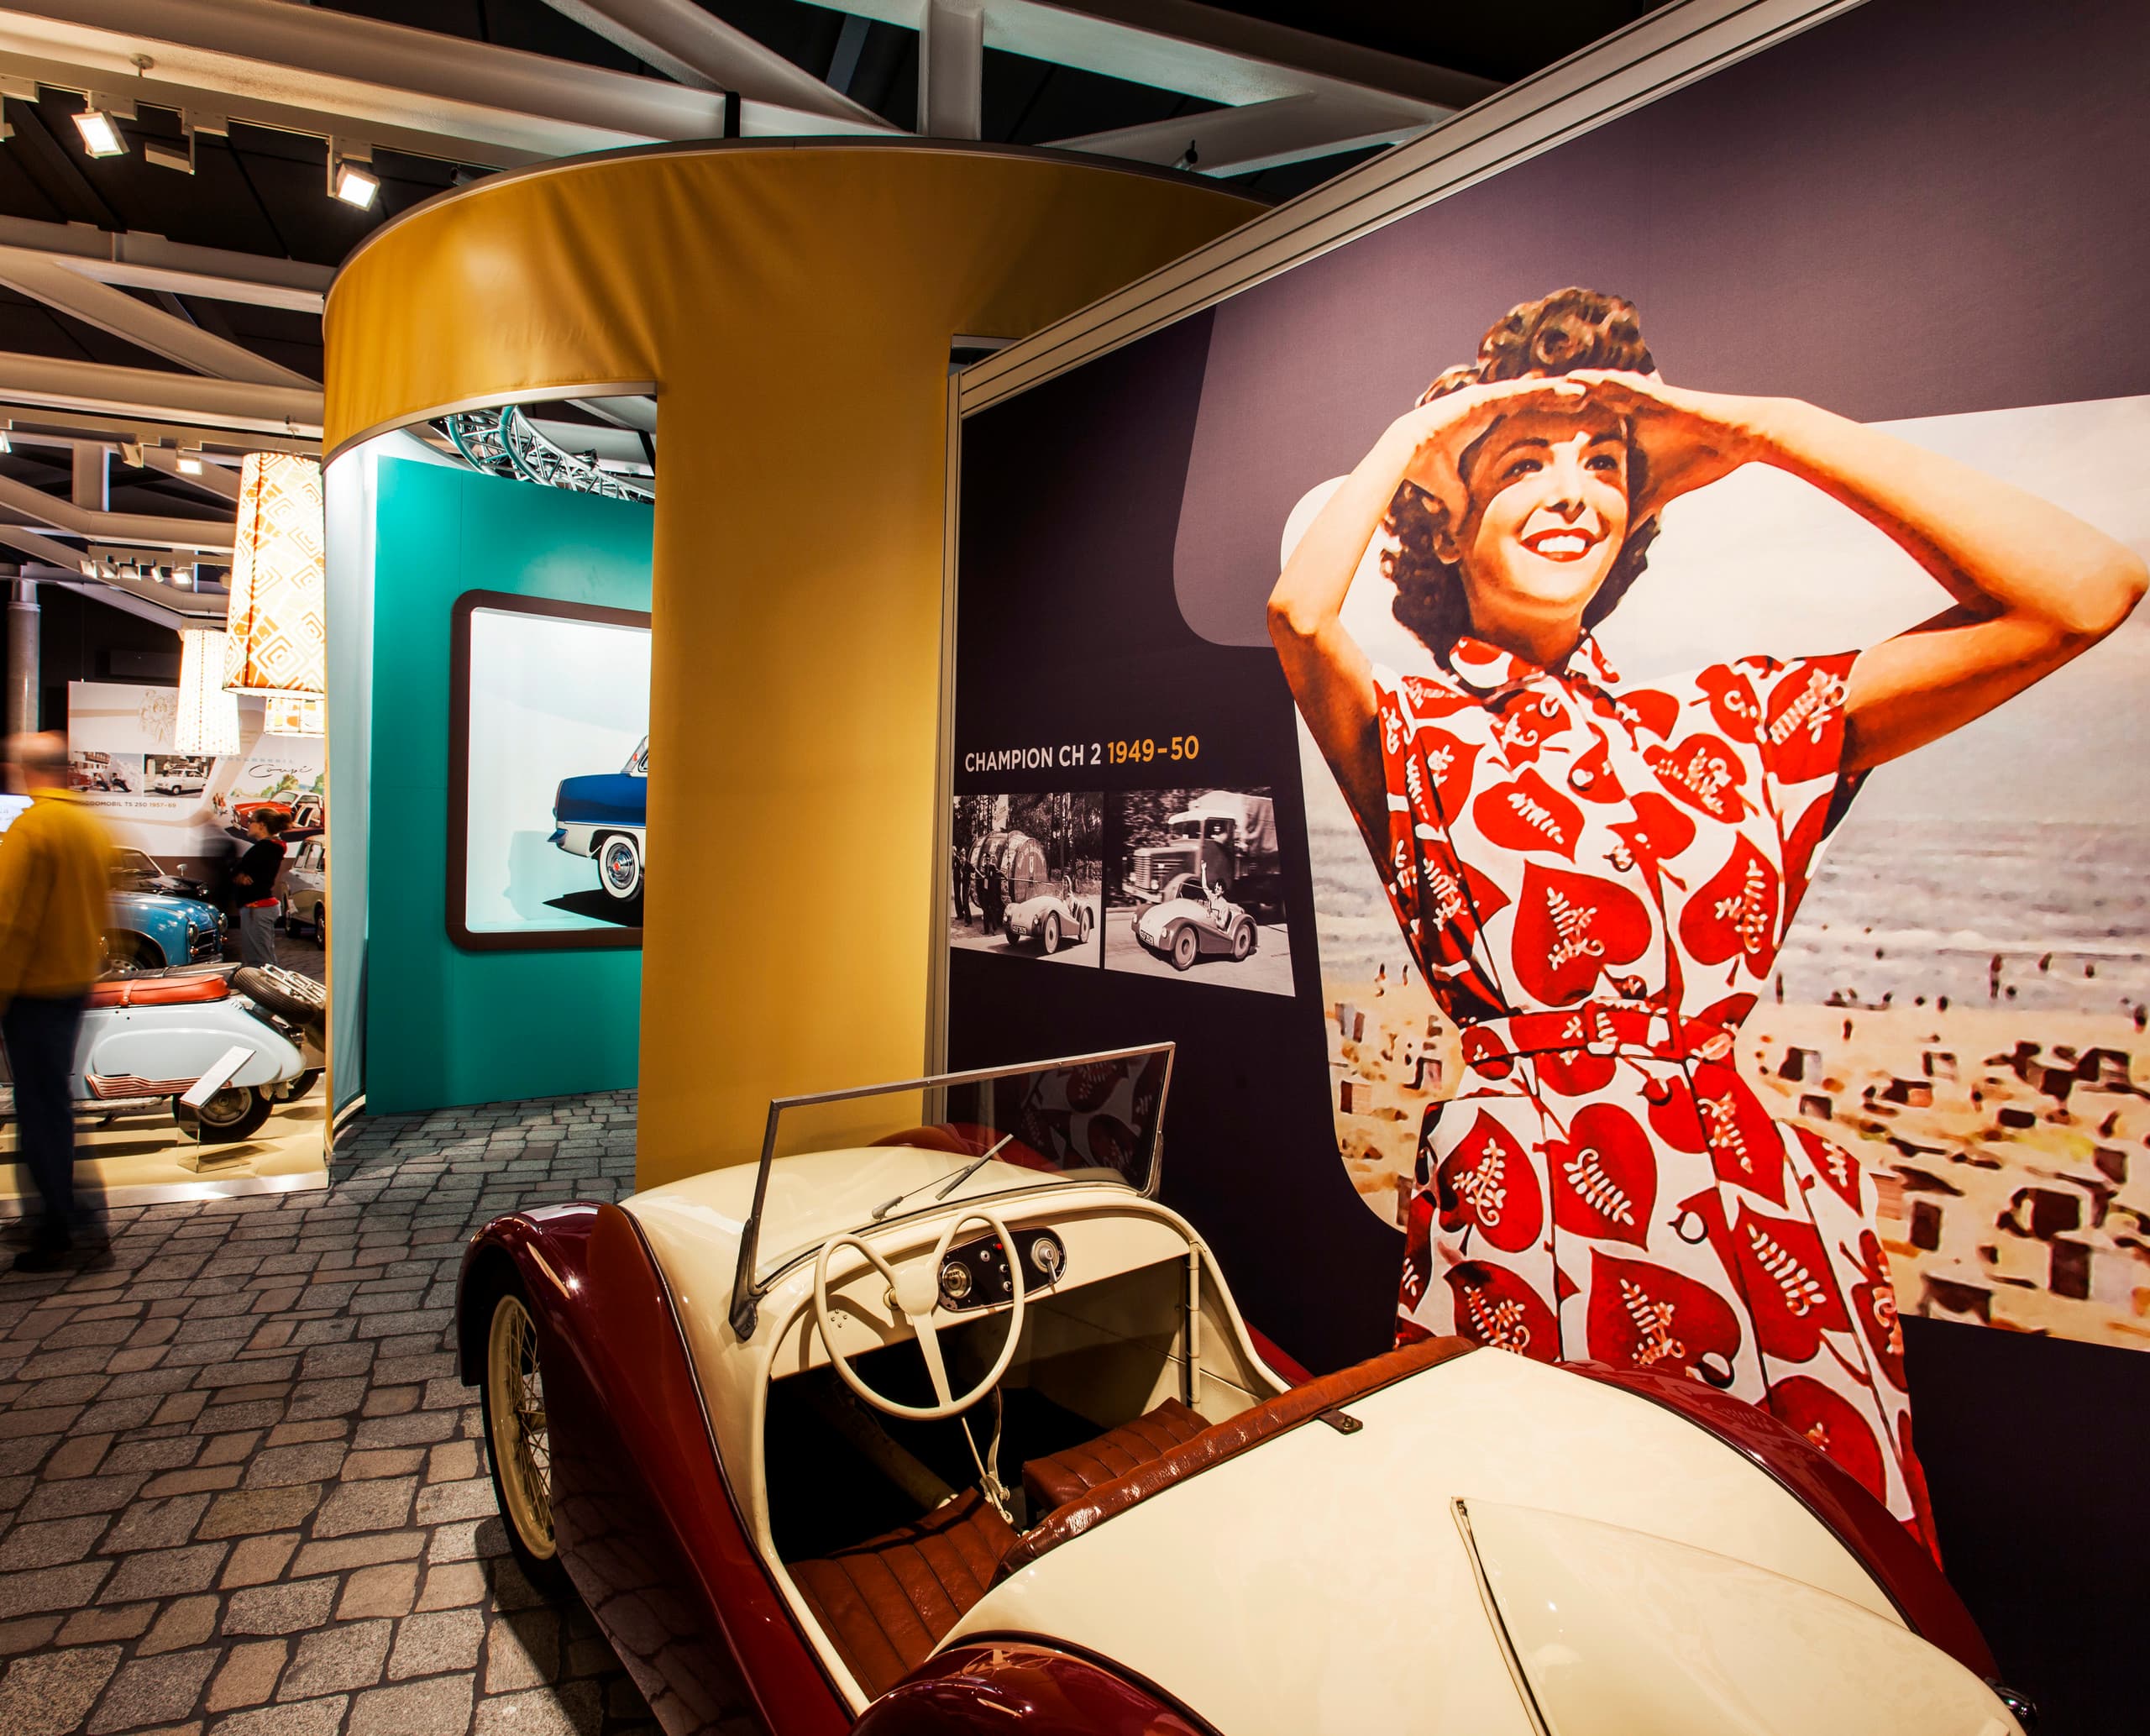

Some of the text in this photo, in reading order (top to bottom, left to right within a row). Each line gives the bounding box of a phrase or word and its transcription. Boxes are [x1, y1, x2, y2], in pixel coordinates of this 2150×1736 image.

[965, 735, 1199, 773] CHAMPION CH 2 1949-50
